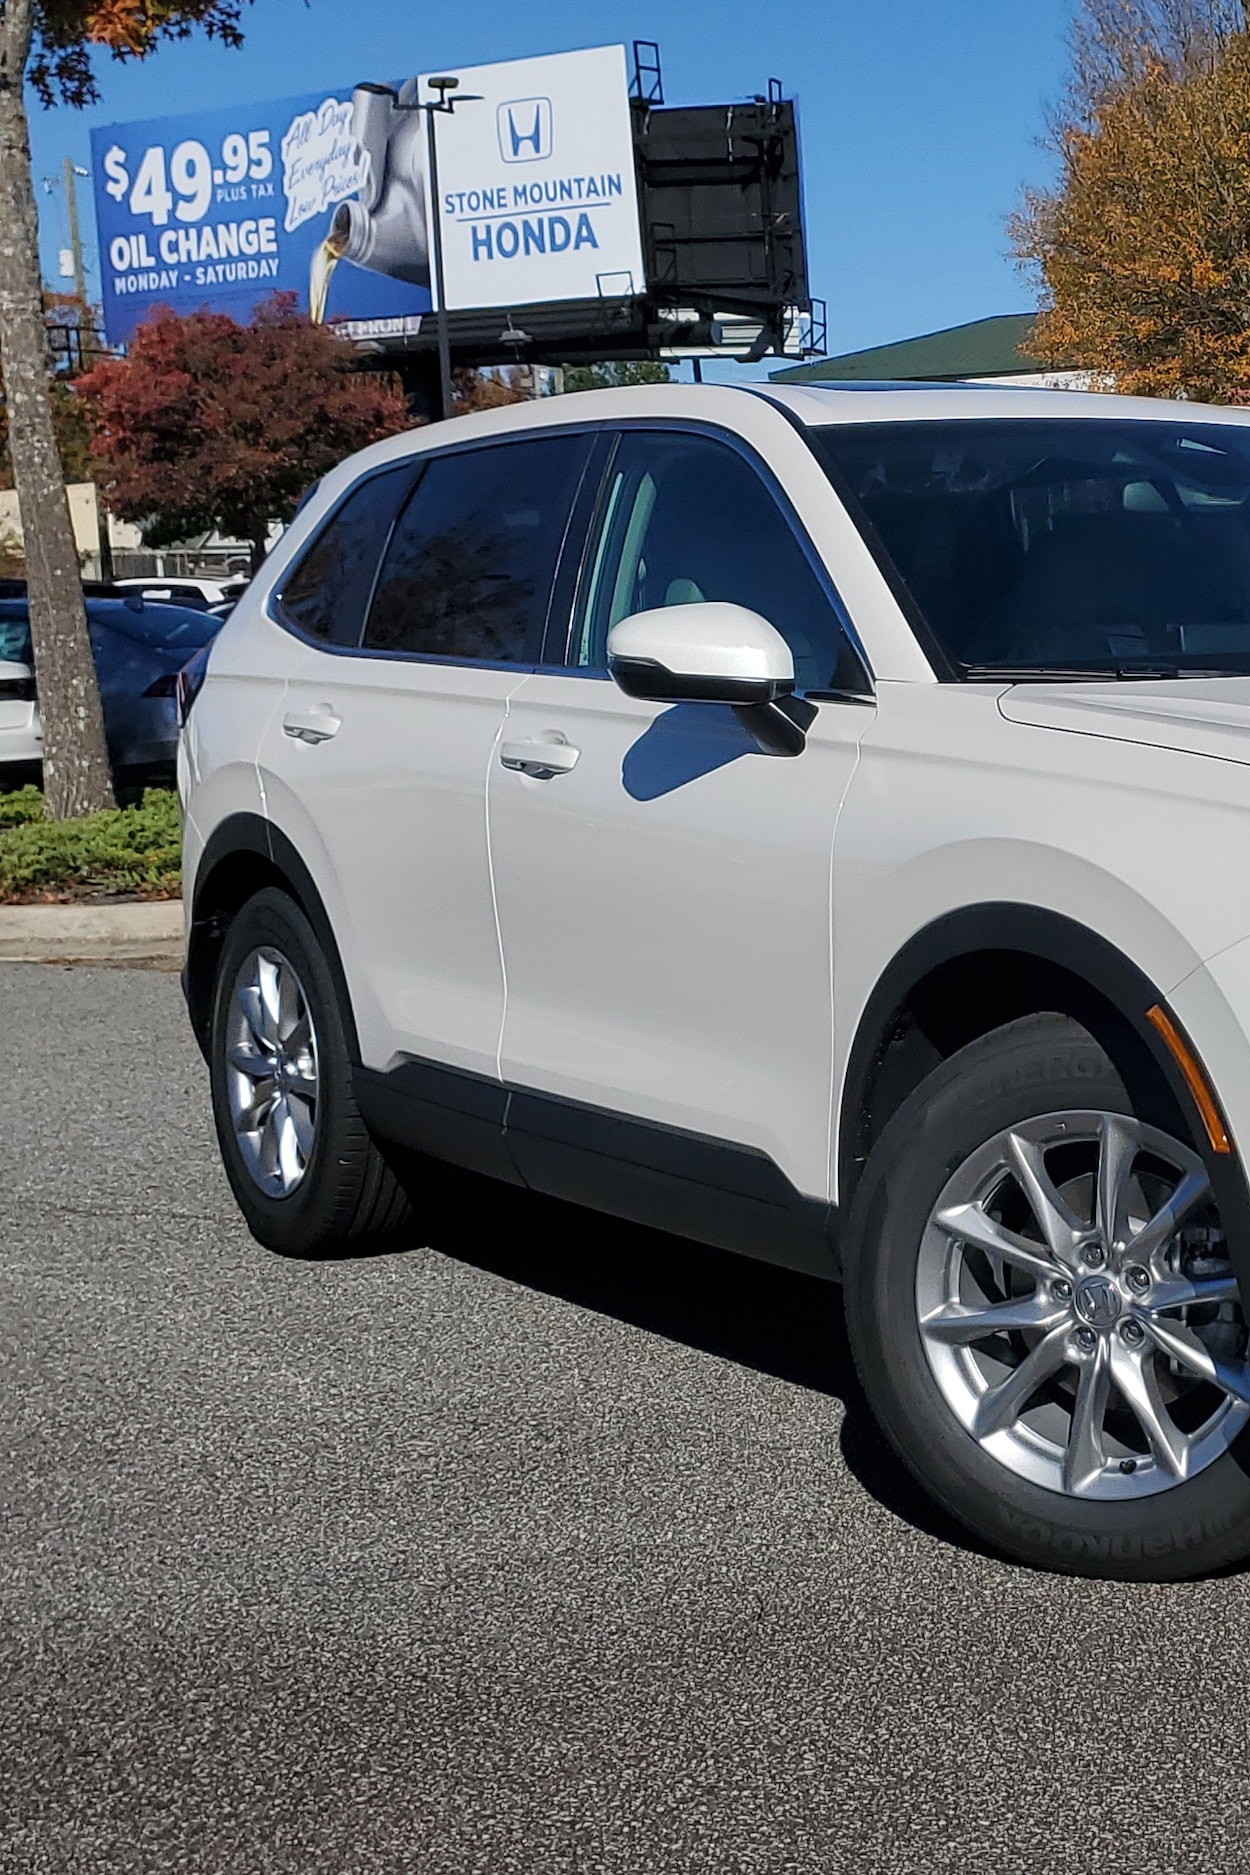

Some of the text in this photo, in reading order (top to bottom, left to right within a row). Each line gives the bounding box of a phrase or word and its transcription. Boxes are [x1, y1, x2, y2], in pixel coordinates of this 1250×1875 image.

[286, 104, 348, 158] All Day
[104, 131, 272, 226] $49.95
[288, 138, 351, 190] Everyday
[216, 182, 275, 203] PLUS TAX
[289, 197, 316, 225] Low
[444, 174, 622, 214] STONE MOUNTAIN
[110, 217, 278, 271] OIL CHANGE
[471, 212, 599, 262] HONDA
[113, 269, 179, 296] MONDAY
[195, 258, 279, 286] SATURDAY
